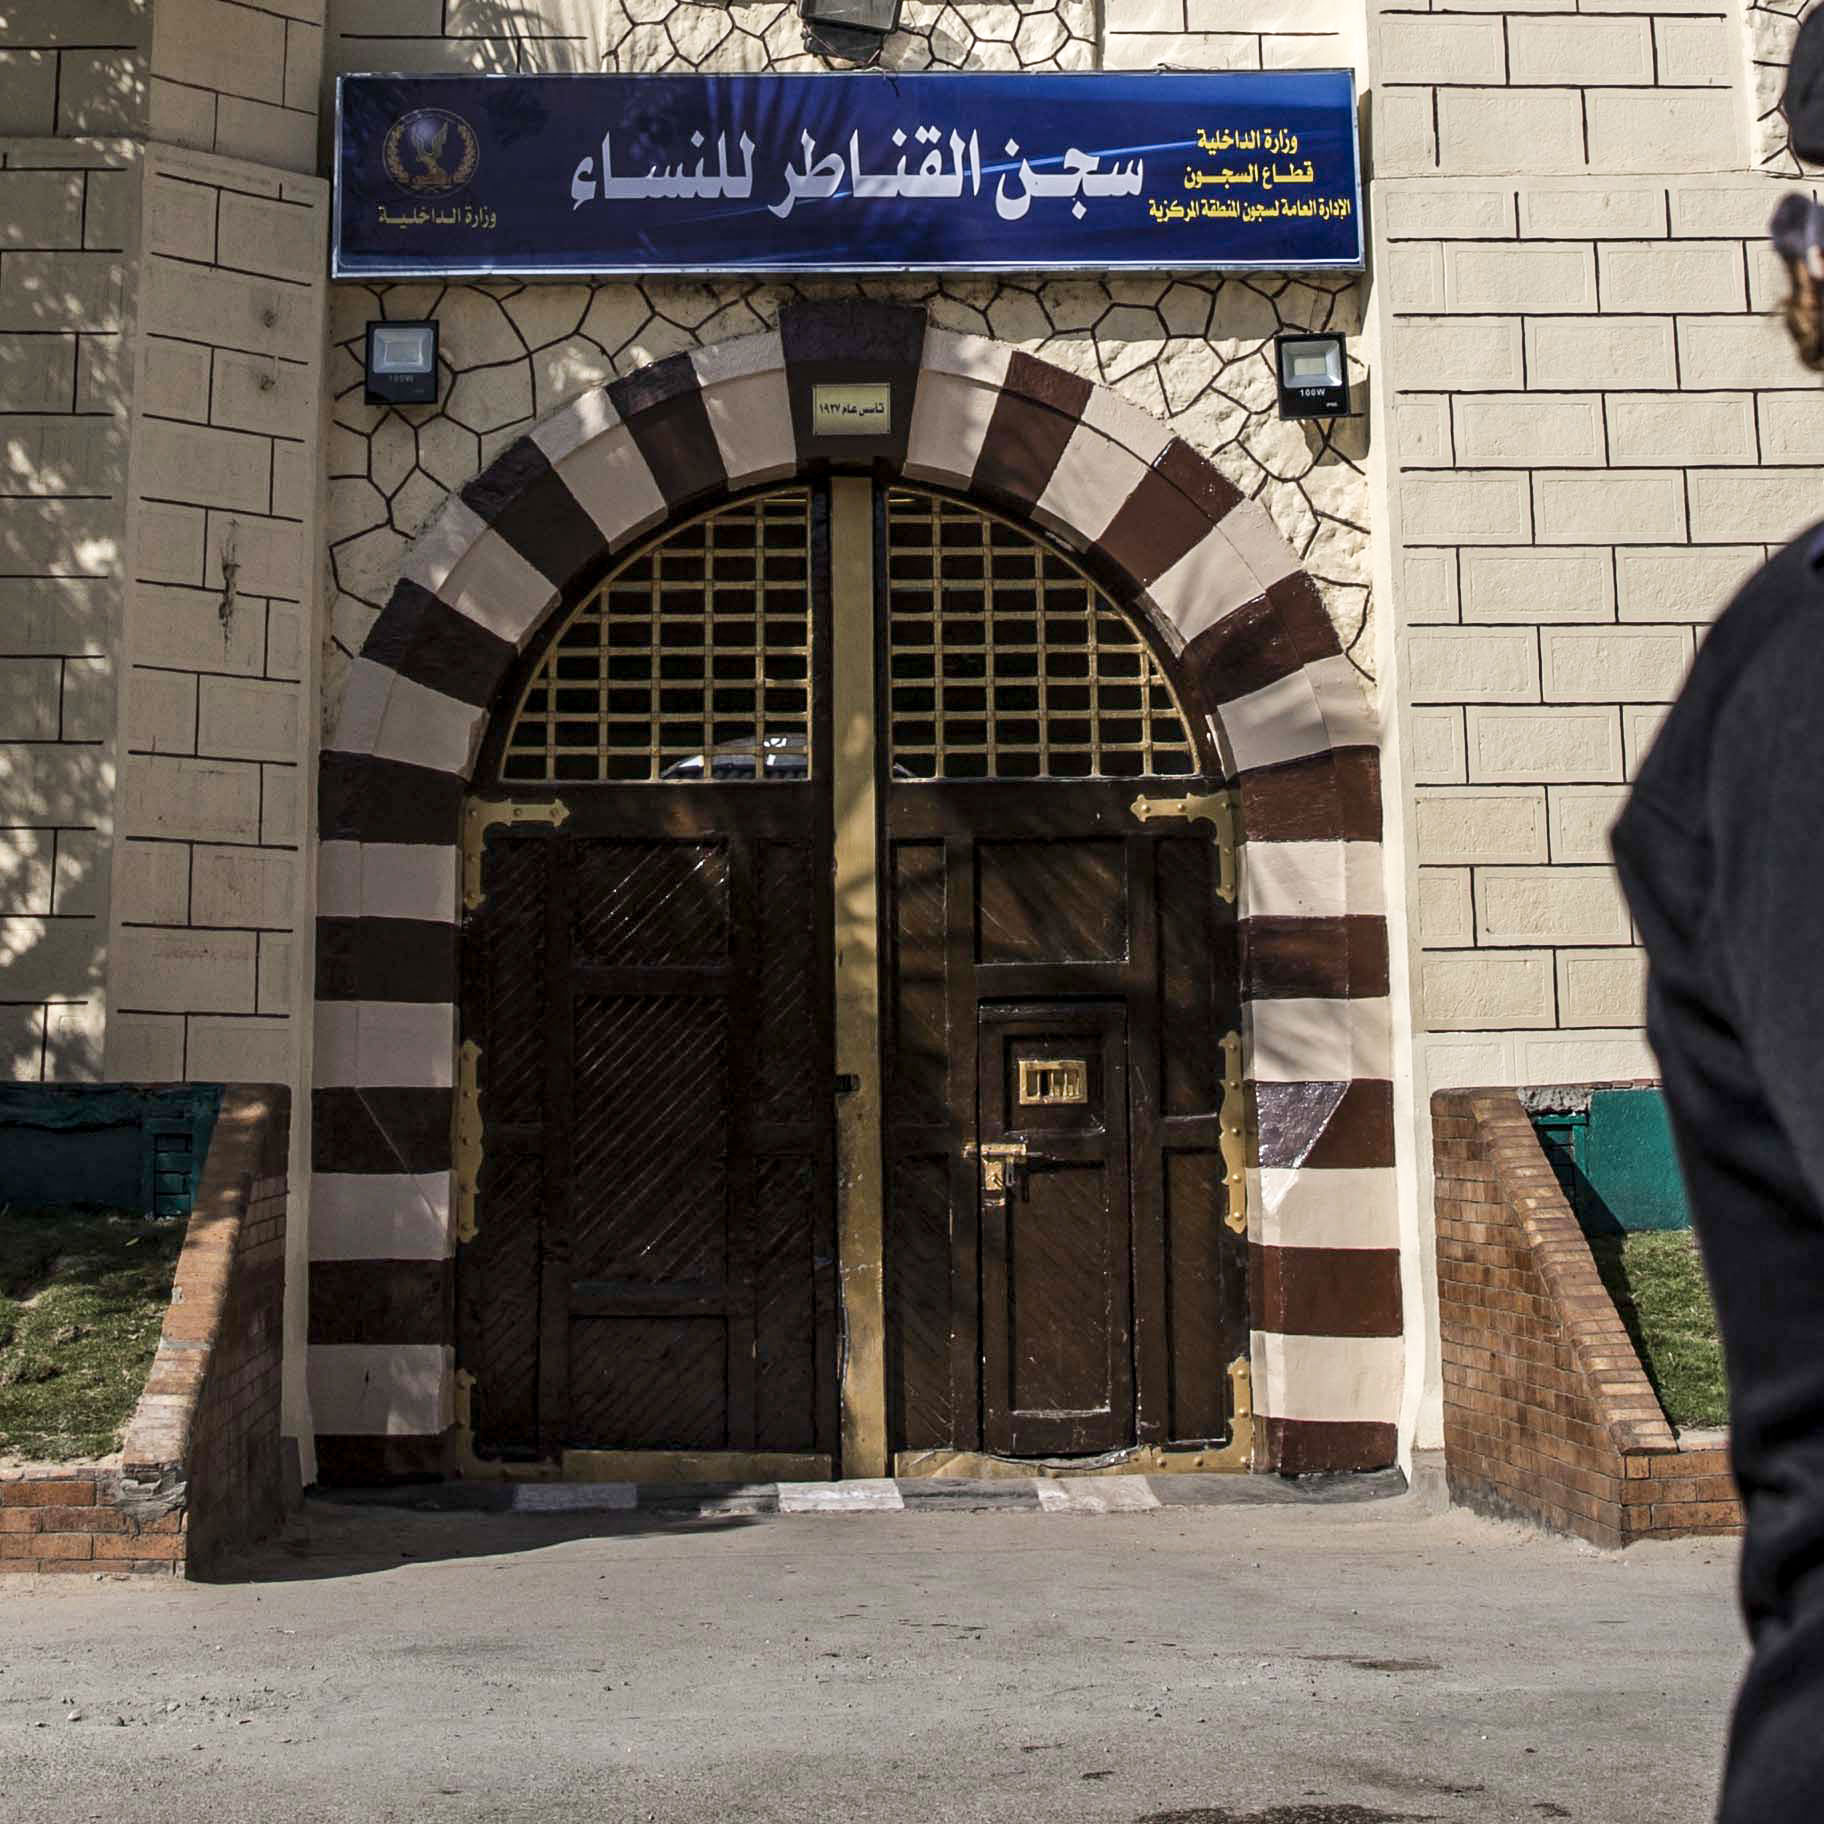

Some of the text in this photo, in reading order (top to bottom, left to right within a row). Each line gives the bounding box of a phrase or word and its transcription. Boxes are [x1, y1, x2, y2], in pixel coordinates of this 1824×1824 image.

[1197, 128, 1298, 155] وزارة الداخلية
[571, 125, 1143, 220] سجن القناطر للنساء
[1183, 161, 1314, 189] قطاع السجون
[377, 205, 497, 229] وزارة الداخلية
[1148, 198, 1351, 223] الإدارة العامة لسجون المنطقة المركزية
[1299, 388, 1326, 397] 100W
[842, 404, 858, 417] عام
